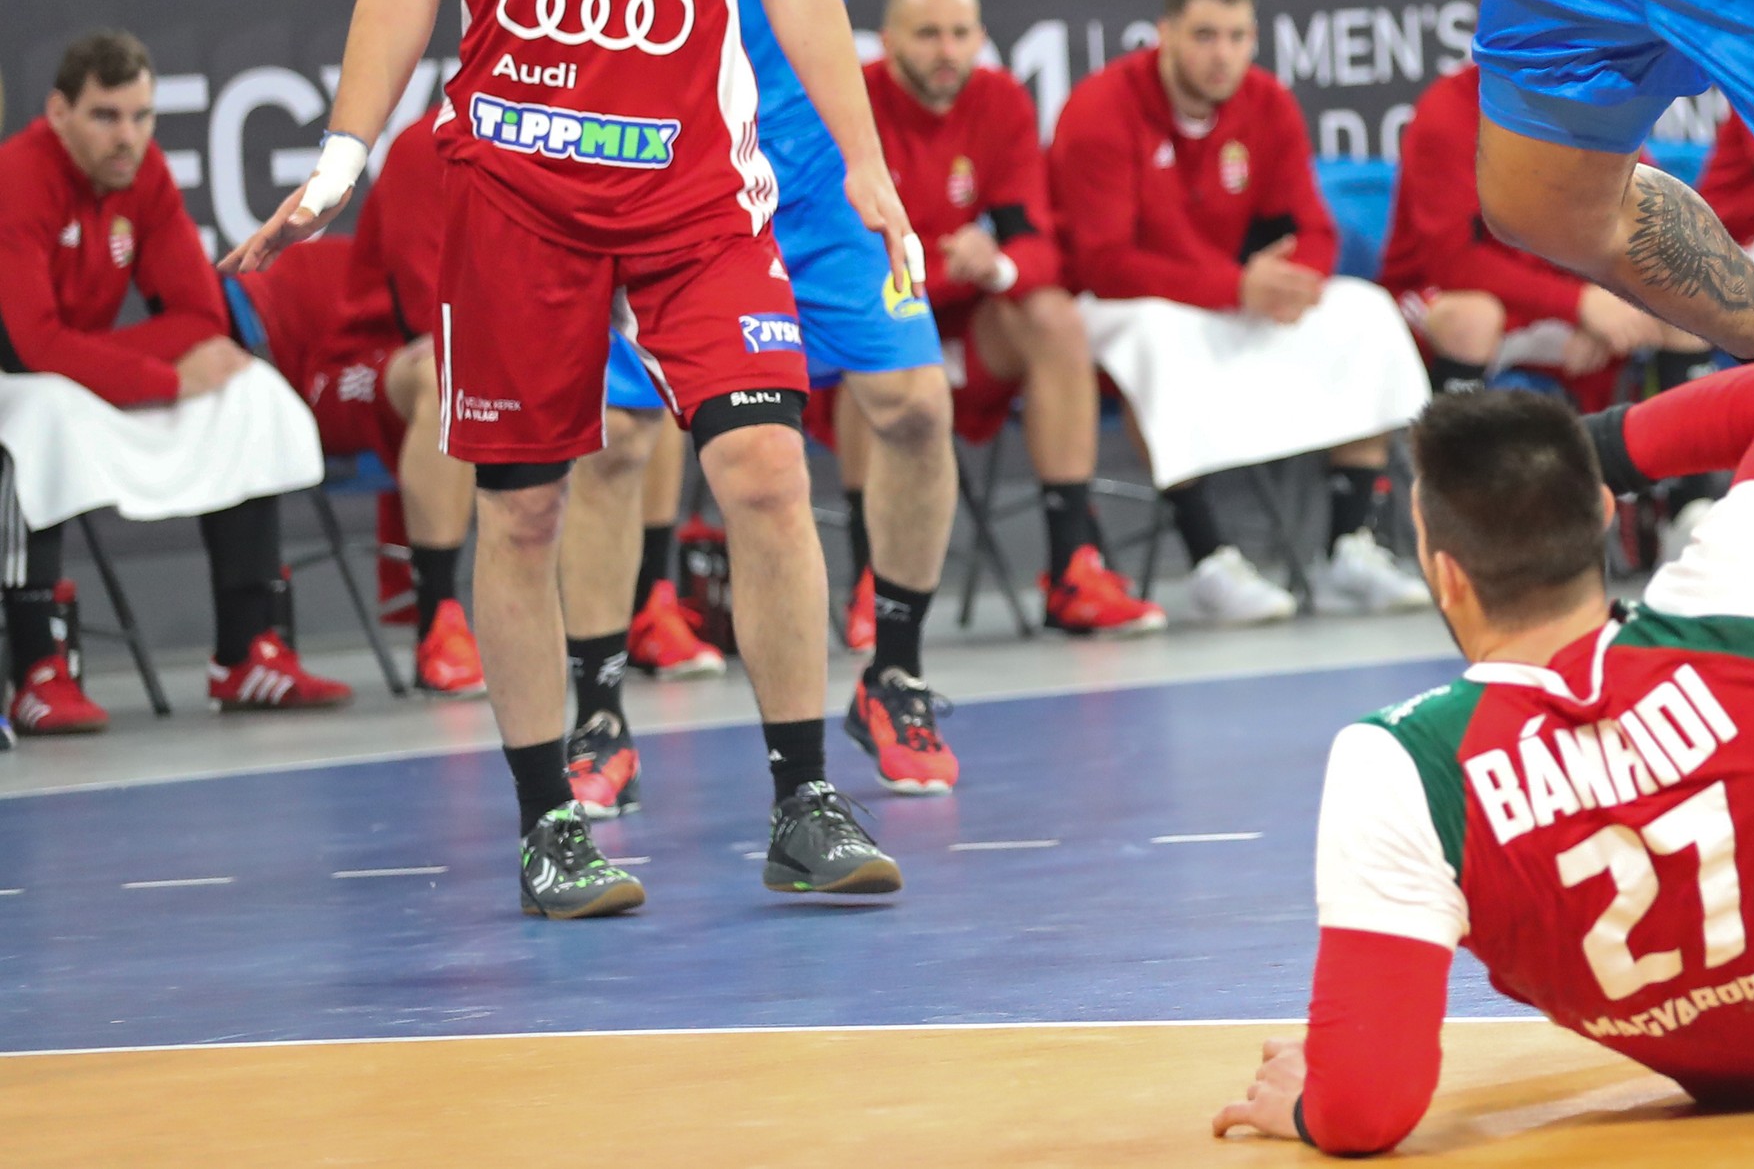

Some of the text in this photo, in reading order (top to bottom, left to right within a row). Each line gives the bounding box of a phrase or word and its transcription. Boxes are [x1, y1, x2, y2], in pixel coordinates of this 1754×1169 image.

[491, 53, 578, 90] Audi
[1272, 0, 1479, 90] MEN'S
[1464, 662, 1739, 846] BÁNHIDI
[1554, 780, 1747, 1001] 27
